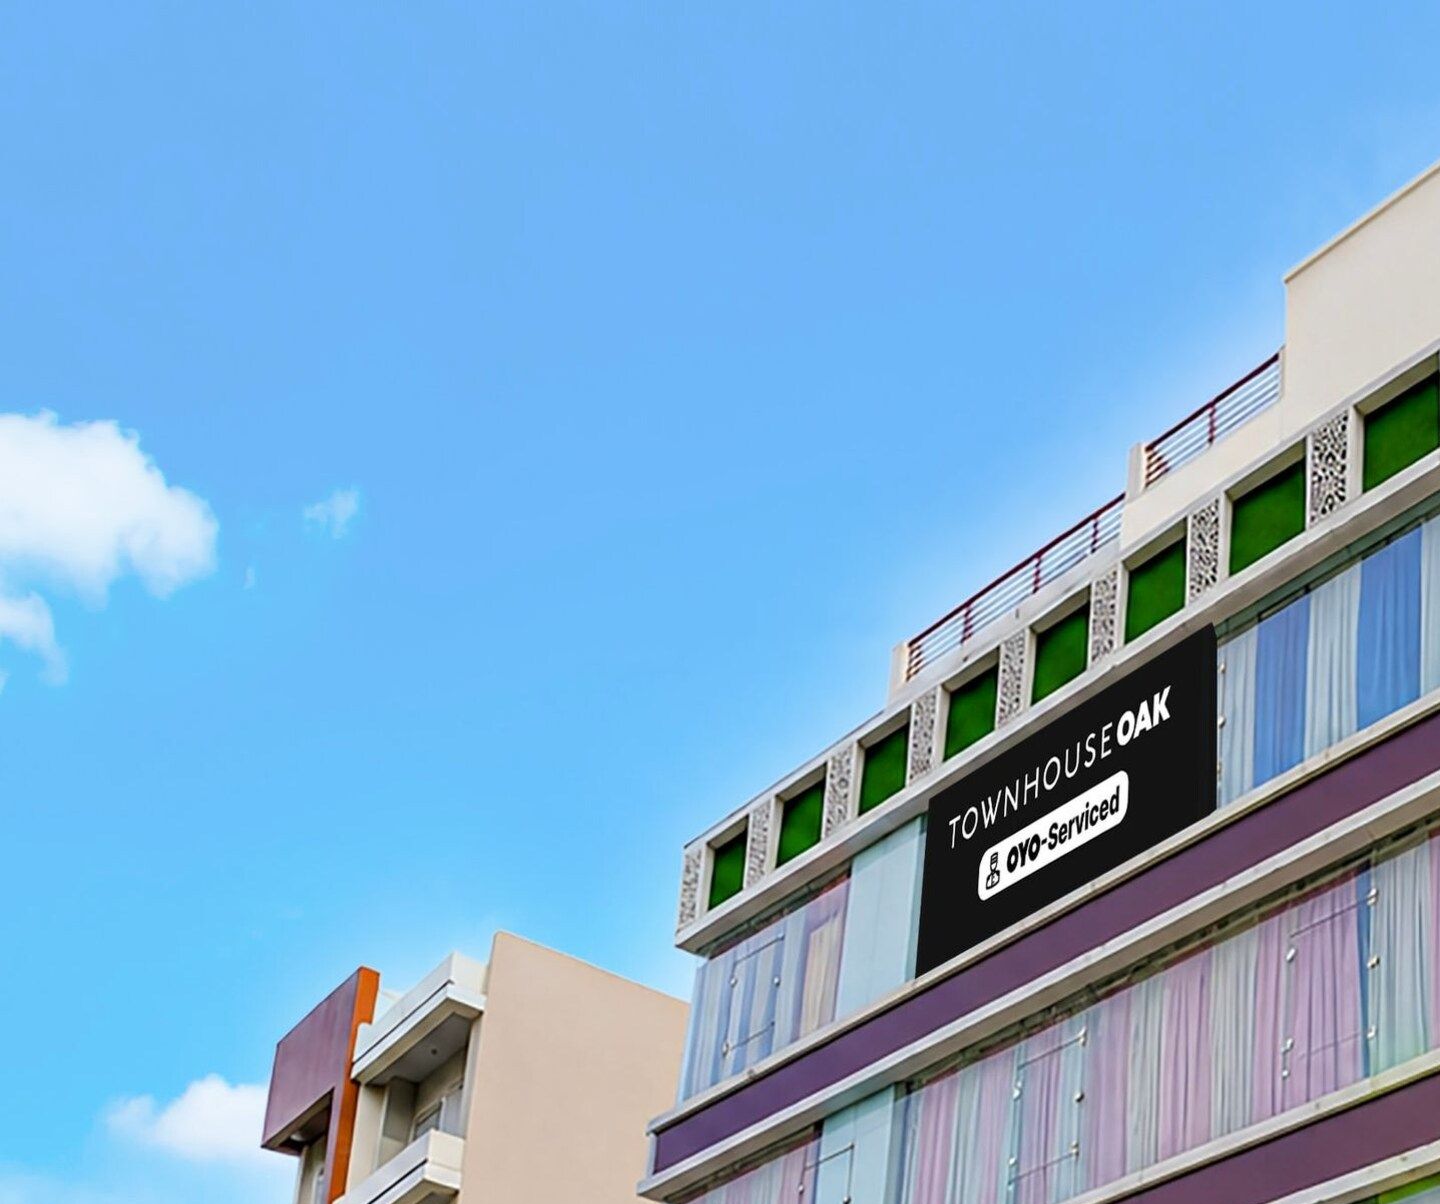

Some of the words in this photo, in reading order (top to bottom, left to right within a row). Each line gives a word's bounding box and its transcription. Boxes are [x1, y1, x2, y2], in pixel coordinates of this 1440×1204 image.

[949, 722, 1112, 849] TOWNHOUSE
[1116, 685, 1171, 746] OAK
[1006, 785, 1120, 873] OYO-Serviced
